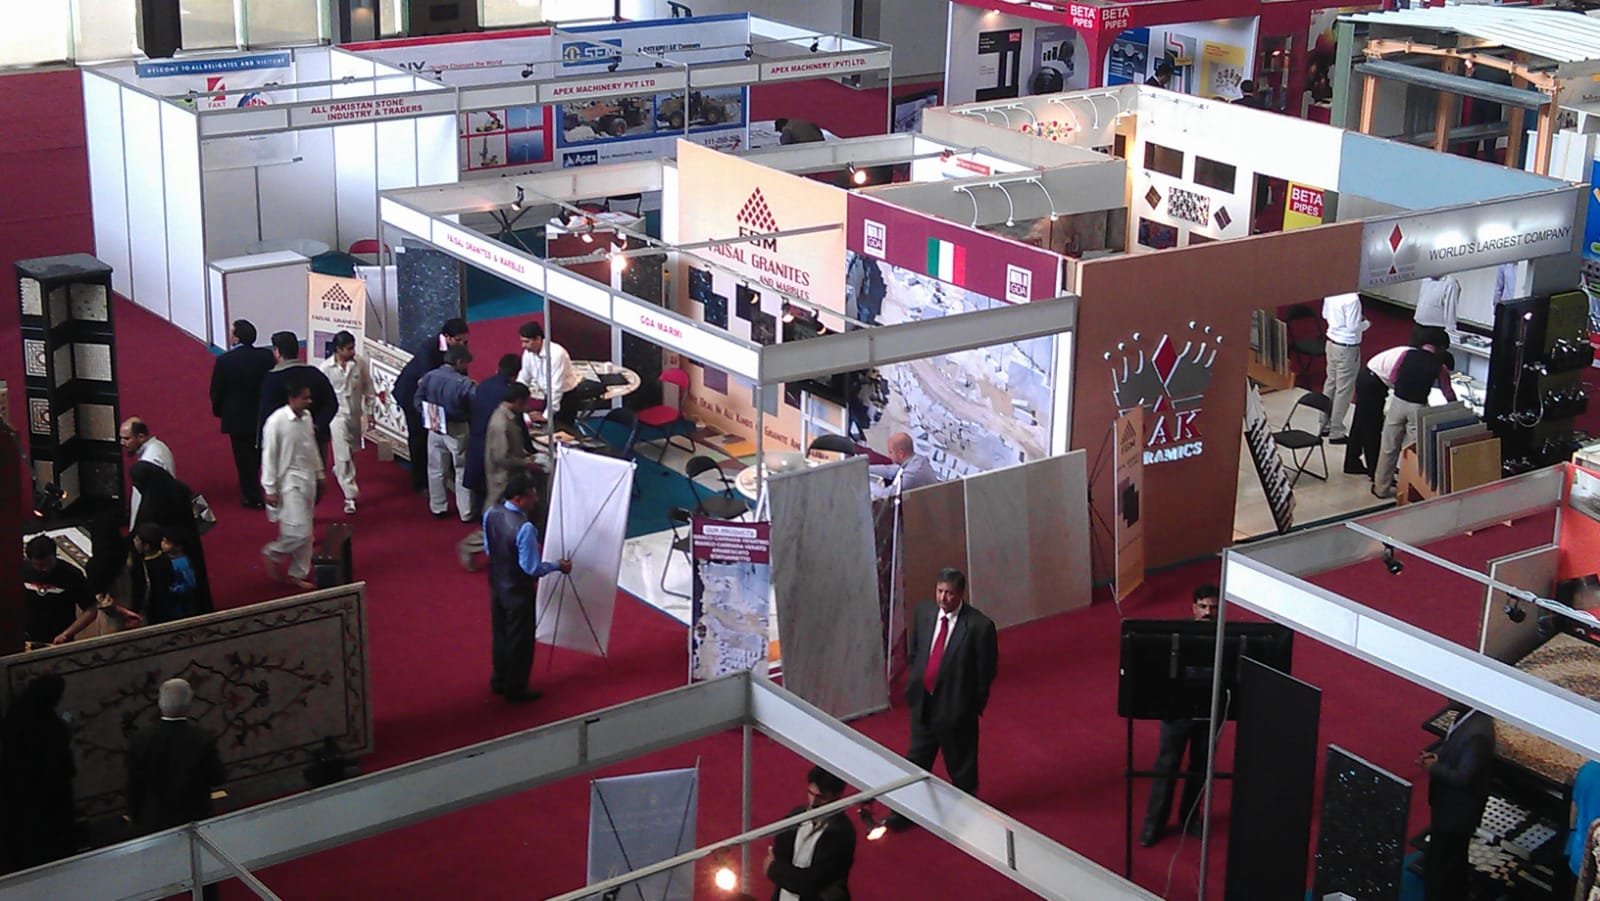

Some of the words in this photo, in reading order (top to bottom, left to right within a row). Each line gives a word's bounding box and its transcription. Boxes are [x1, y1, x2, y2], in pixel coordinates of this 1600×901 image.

[1070, 4, 1096, 19] BETA
[1102, 8, 1130, 20] BETA
[1072, 17, 1093, 29] PIPES
[1105, 19, 1127, 30] PIPES
[771, 66, 790, 74] APEX
[790, 62, 831, 72] MACHINERY
[833, 60, 851, 70] (PVT)
[852, 58, 867, 66] LTD.
[553, 87, 575, 96] APEX
[576, 82, 622, 94] MACHINERY
[623, 81, 640, 90] PVT
[640, 79, 656, 88] LTD
[311, 106, 328, 114] ALL
[330, 101, 373, 112] PAKISTAN
[375, 98, 404, 108] STONE
[327, 110, 372, 120] INDUSTRY
[374, 108, 381, 116] &
[383, 104, 423, 115] TRADERS
[575, 153, 597, 164] Apex
[1291, 187, 1324, 207] BETA
[1293, 203, 1318, 216] PIPES
[1429, 242, 1475, 260] WORLD'S
[1477, 234, 1523, 253] LARGEST
[1524, 225, 1572, 245] COMPANY
[707, 238, 747, 265] FAISAL
[751, 254, 810, 287] GRANITES
[759, 275, 774, 286] AND
[1009, 283, 1027, 296] GDA
[322, 301, 352, 312] FGM
[1147, 408, 1203, 447] AK
[1142, 441, 1203, 465] RAMICS
